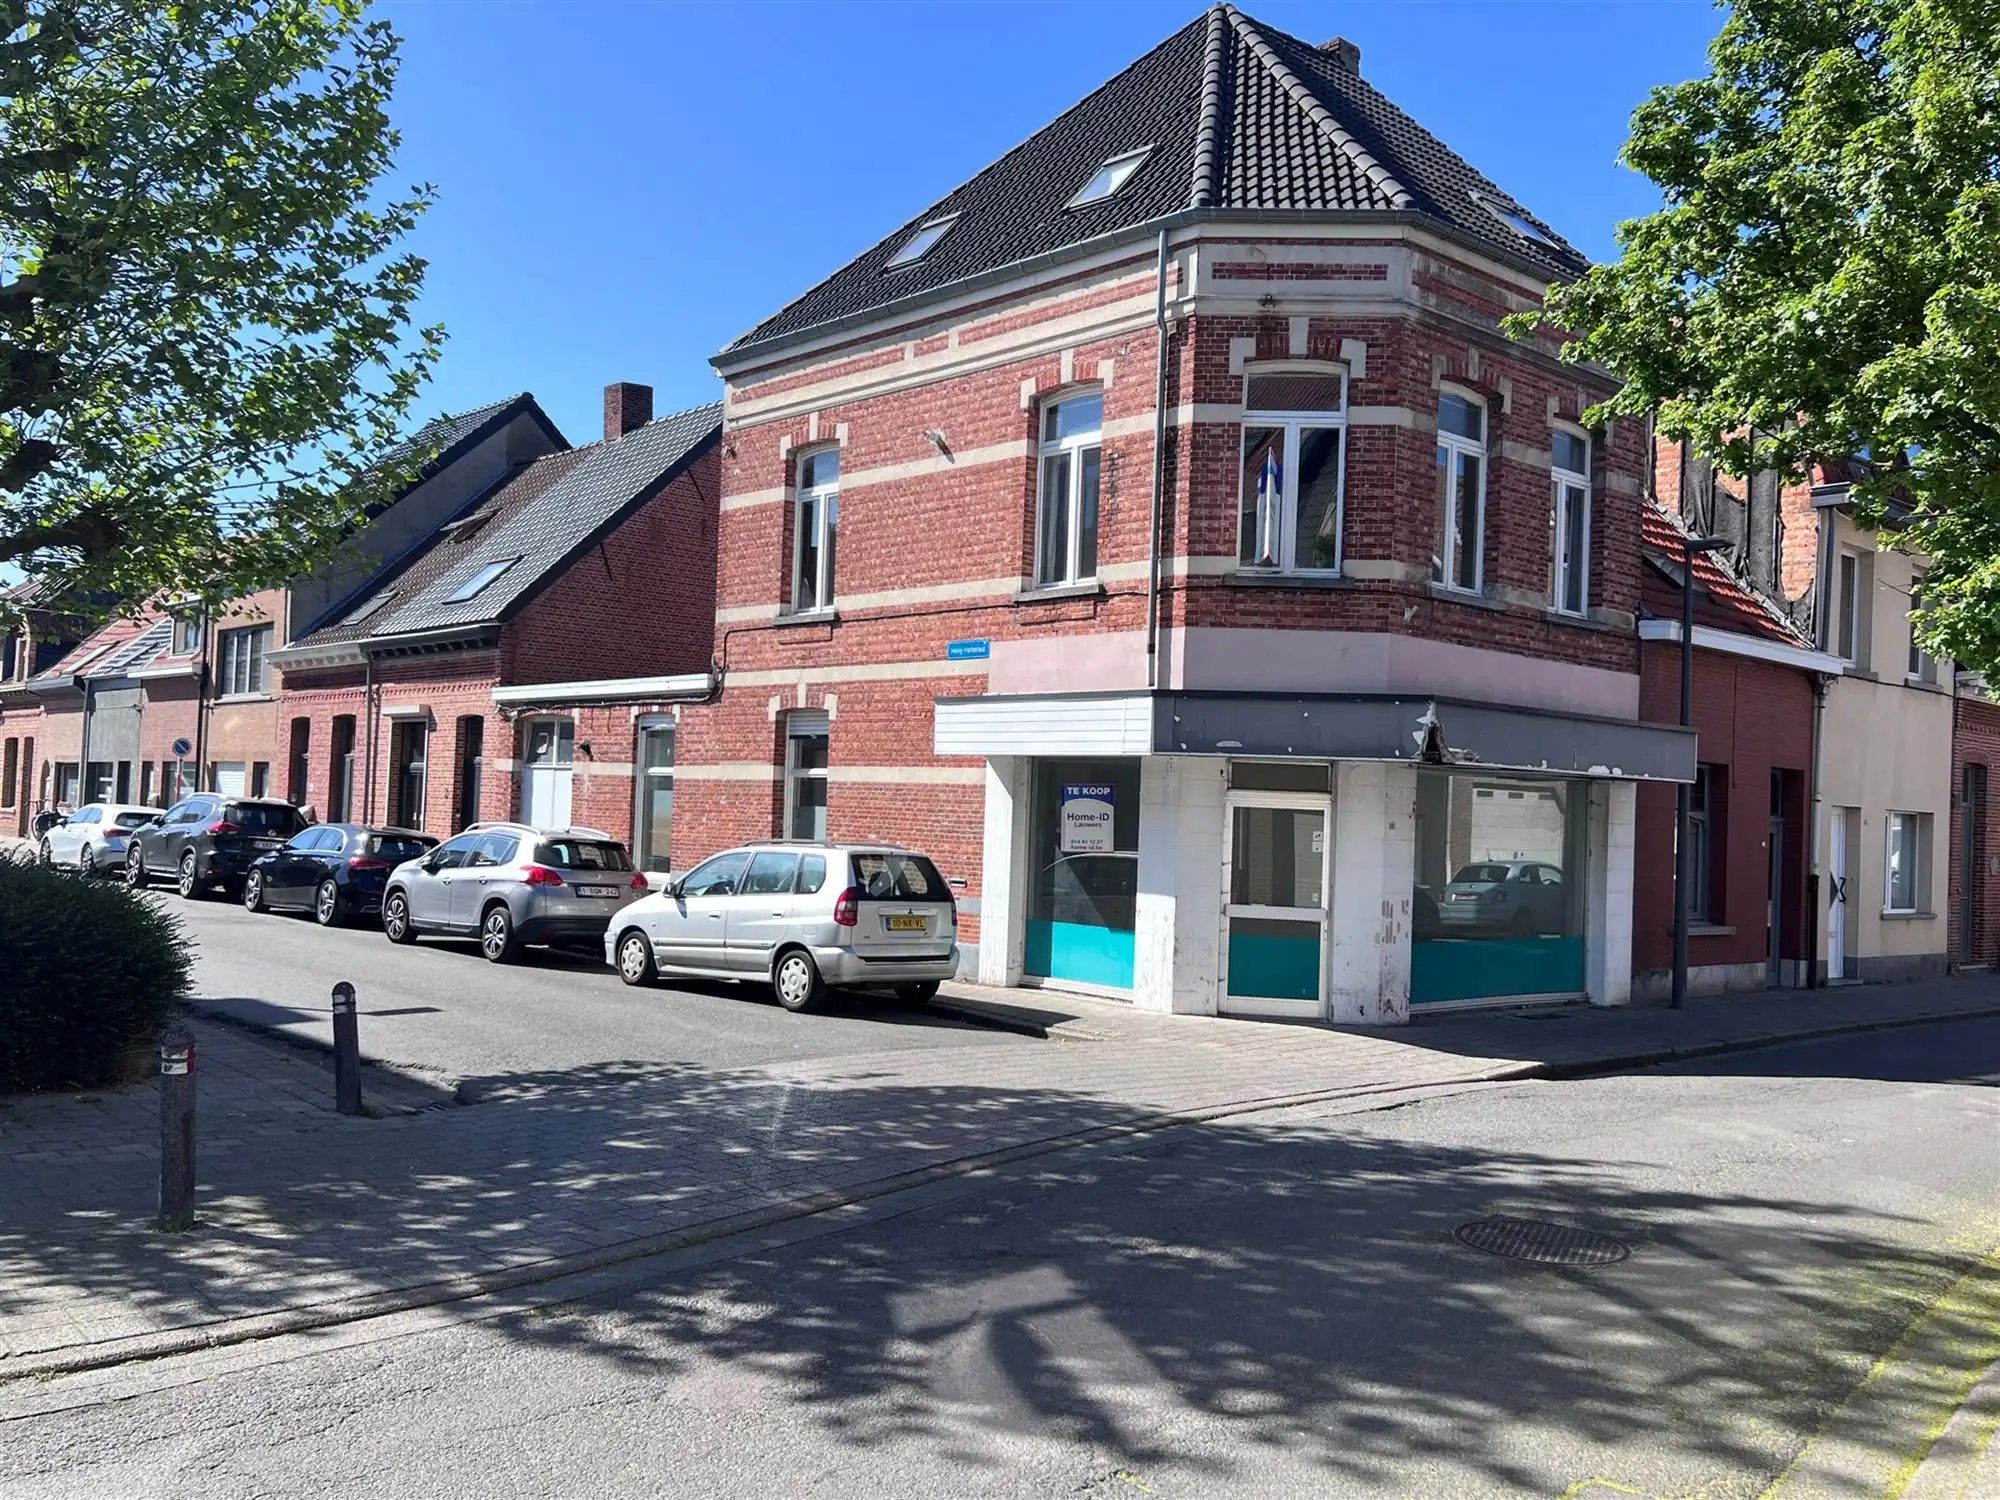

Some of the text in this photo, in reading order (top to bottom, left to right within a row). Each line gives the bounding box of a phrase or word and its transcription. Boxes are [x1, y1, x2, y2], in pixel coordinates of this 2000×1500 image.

[1067, 787, 1111, 795] TE KOOP
[1067, 813, 1110, 821] Home-ID
[892, 919, 924, 928] 10-NK-VL
